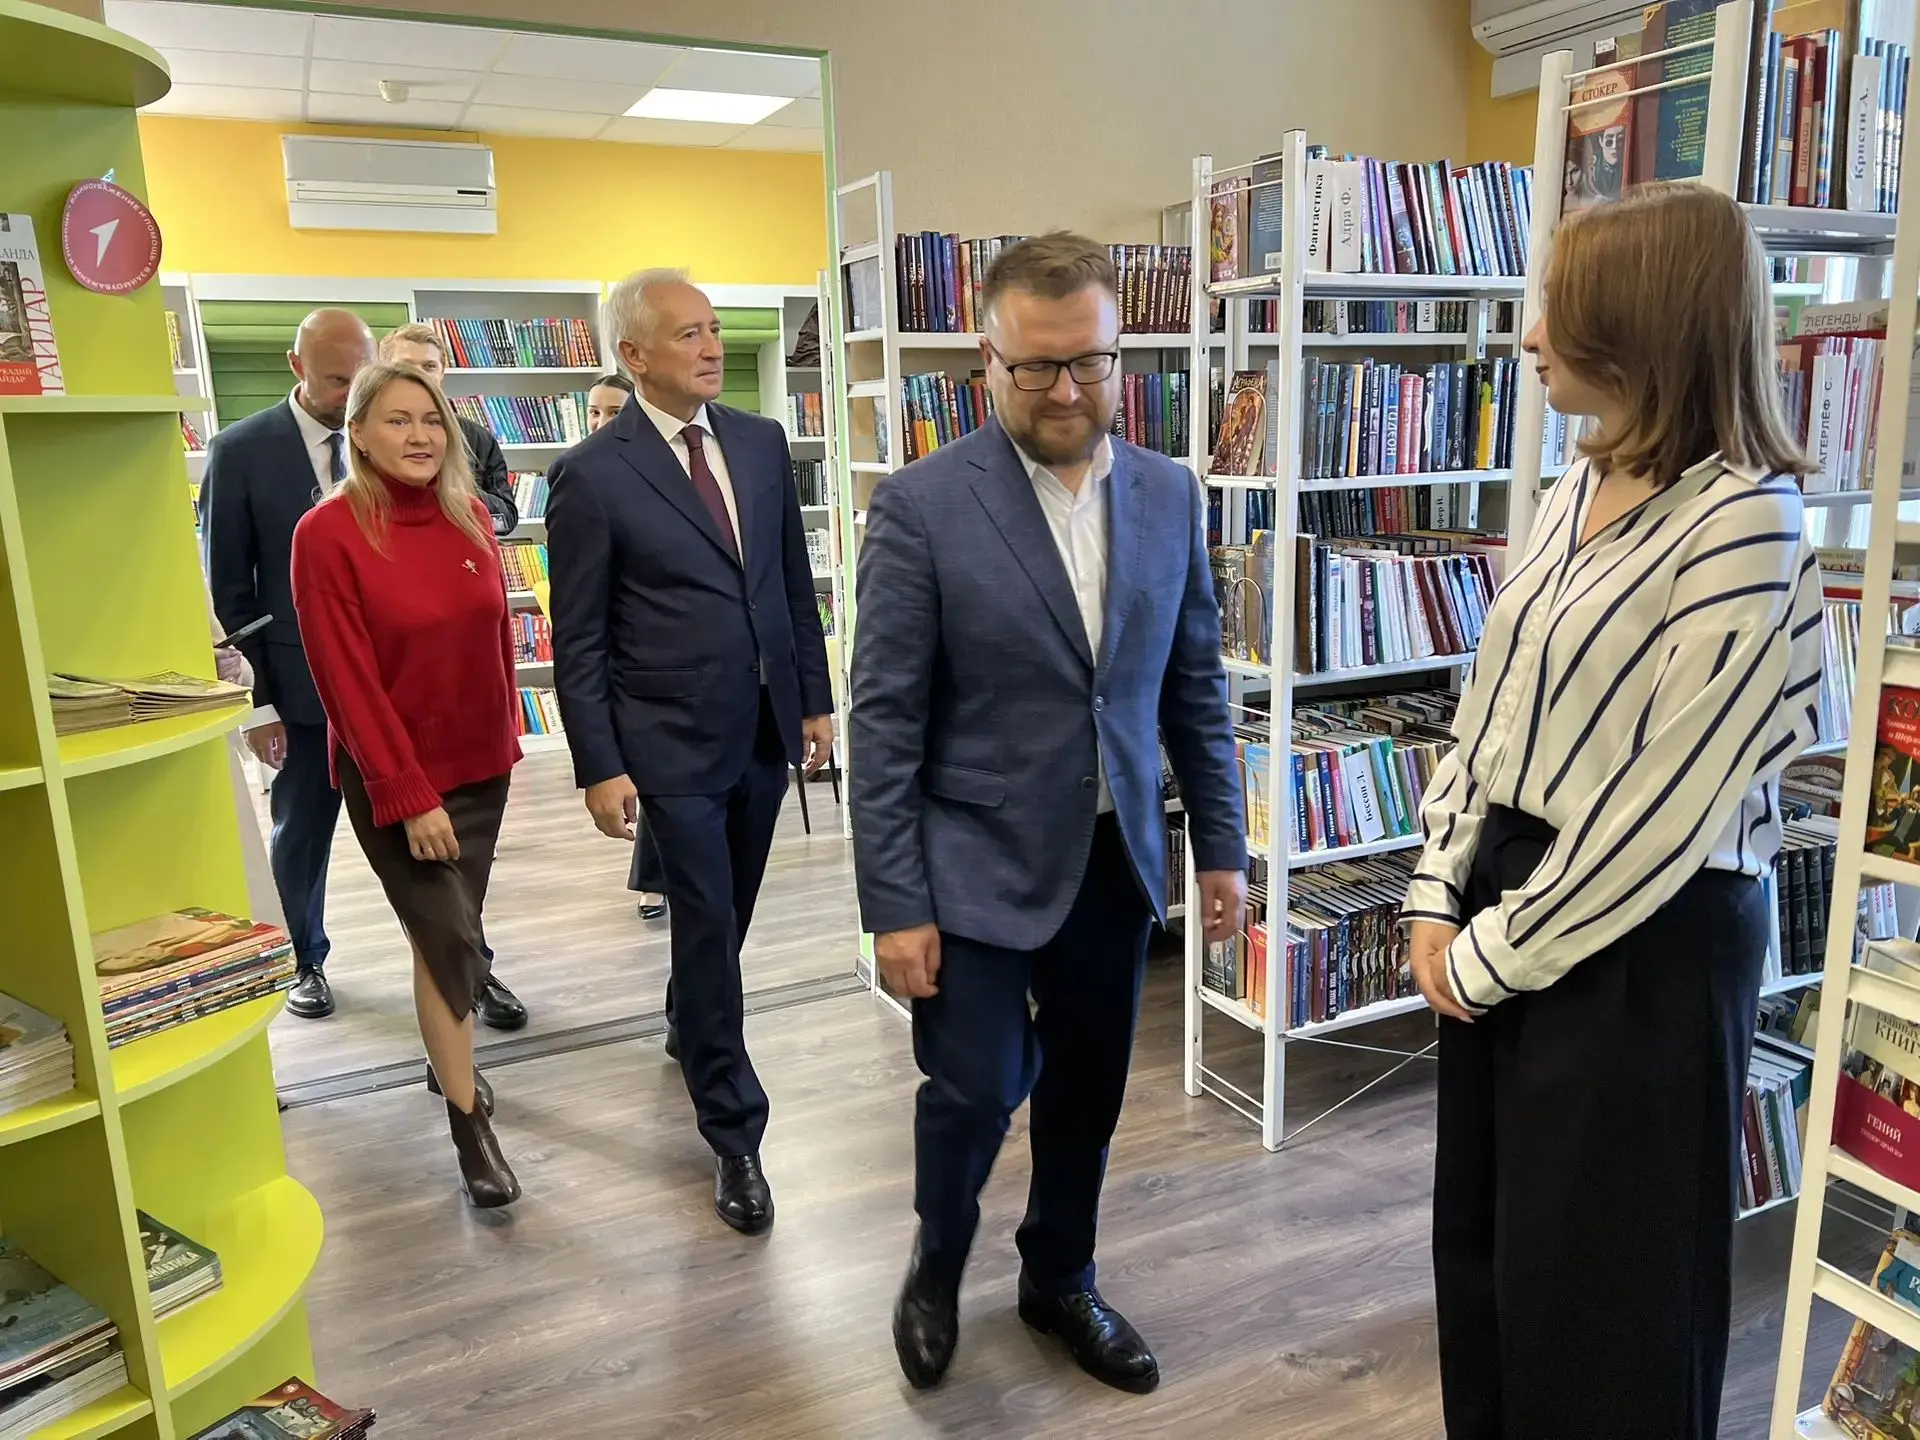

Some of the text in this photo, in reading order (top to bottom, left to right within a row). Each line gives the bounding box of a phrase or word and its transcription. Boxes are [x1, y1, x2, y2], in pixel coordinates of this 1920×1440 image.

[1581, 82, 1618, 102] СТОКЕР
[1854, 113, 1867, 180] Кристи
[1308, 173, 1324, 257] Фантастика
[1340, 186, 1354, 247] Адра Ф.
[0, 247, 35, 260] АНДА
[1804, 312, 1862, 328] ЛЕГЕНДЫ
[0, 367, 32, 376] РКАДИЙ
[0, 375, 26, 383] АЙДАР
[1386, 404, 1399, 456] ГИДЕОН
[1887, 694, 1920, 720] КО
[1360, 785, 1373, 823] Бессон
[1866, 1112, 1902, 1144] ГЕНИЙ
[145, 1250, 201, 1278] НАВТИКА
